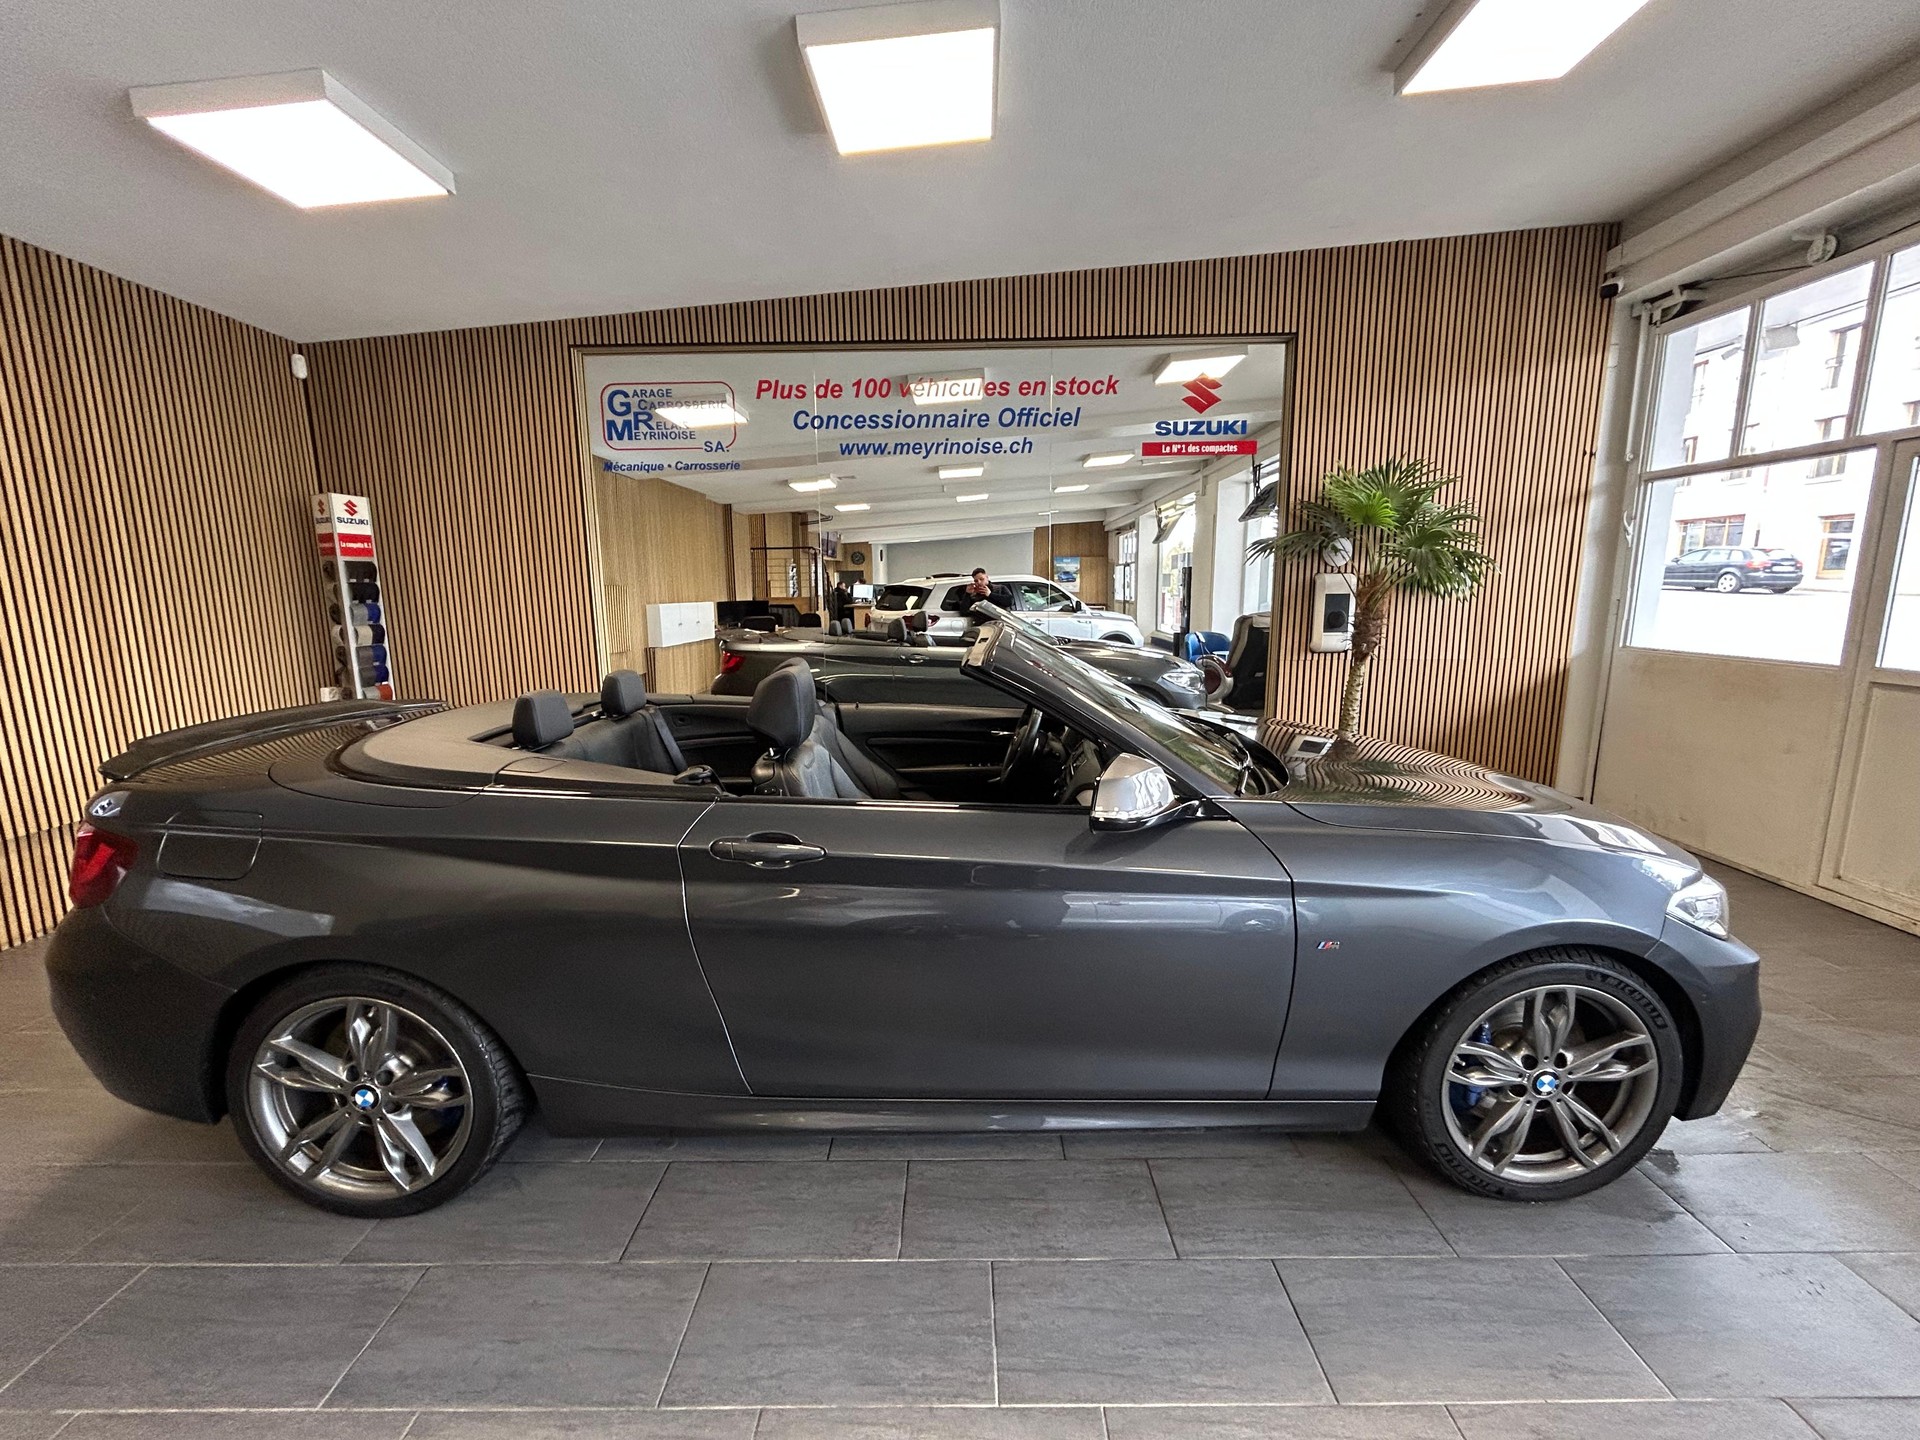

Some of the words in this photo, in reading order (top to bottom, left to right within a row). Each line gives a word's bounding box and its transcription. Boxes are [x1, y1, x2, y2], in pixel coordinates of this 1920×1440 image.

[756, 379, 807, 400] Plus
[815, 378, 843, 399] de
[852, 378, 892, 399] 100
[899, 375, 1010, 398] véhicules
[1018, 380, 1047, 397] en
[1053, 374, 1120, 396] stock
[607, 388, 673, 417] GARAGE
[793, 408, 990, 430] Concessionnaire
[998, 407, 1081, 428] Officiel
[1155, 420, 1247, 436] SUZUKI
[606, 419, 697, 441] MEYRINOISE
[703, 440, 730, 453] SA.
[839, 437, 1034, 460] www.meyrinoise.ch
[1162, 444, 1171, 453] Le
[1187, 444, 1200, 453] des
[1201, 444, 1238, 454] compactes
[603, 461, 665, 474] Mécanique
[674, 459, 741, 471] Carrosserie
[336, 516, 369, 526] SUZUKI
